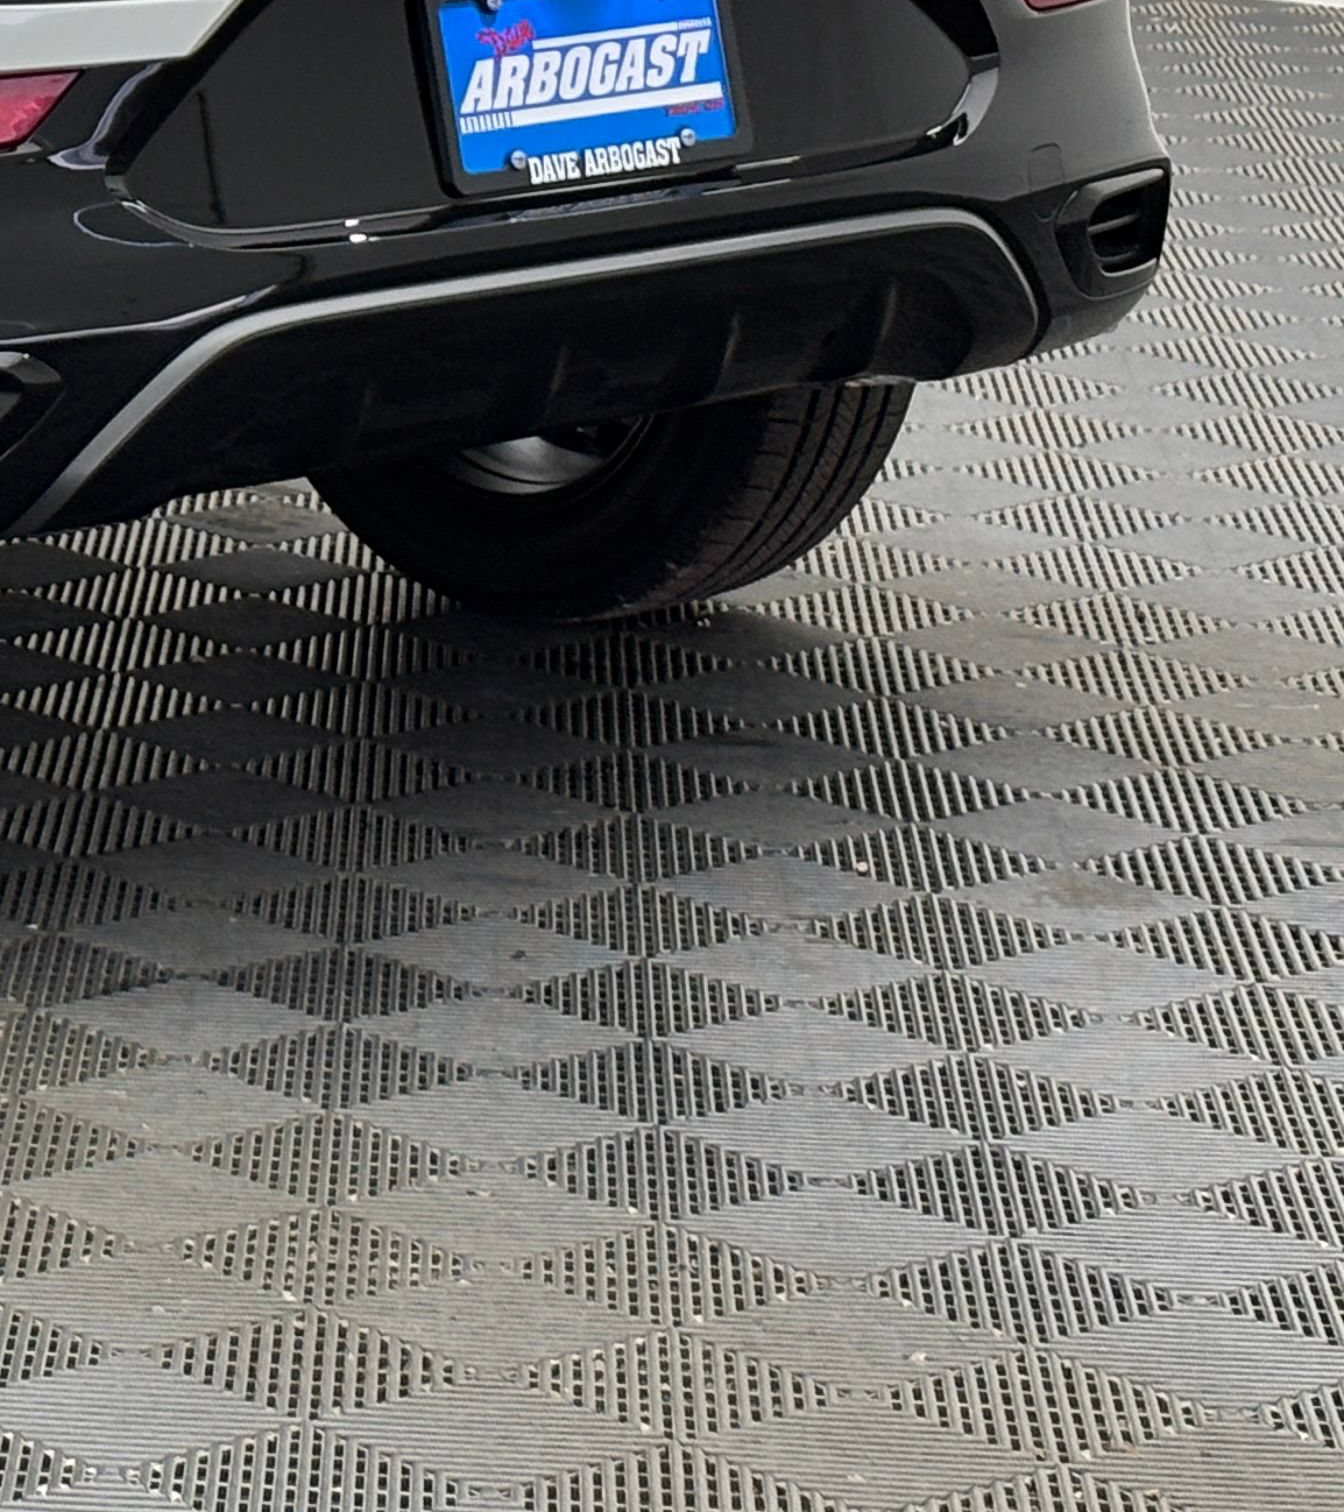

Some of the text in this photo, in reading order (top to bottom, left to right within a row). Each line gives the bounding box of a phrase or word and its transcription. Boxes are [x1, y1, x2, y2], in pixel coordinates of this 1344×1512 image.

[460, 29, 711, 114] ARBOGAST
[527, 136, 682, 185] DAVE ARBOGAST
